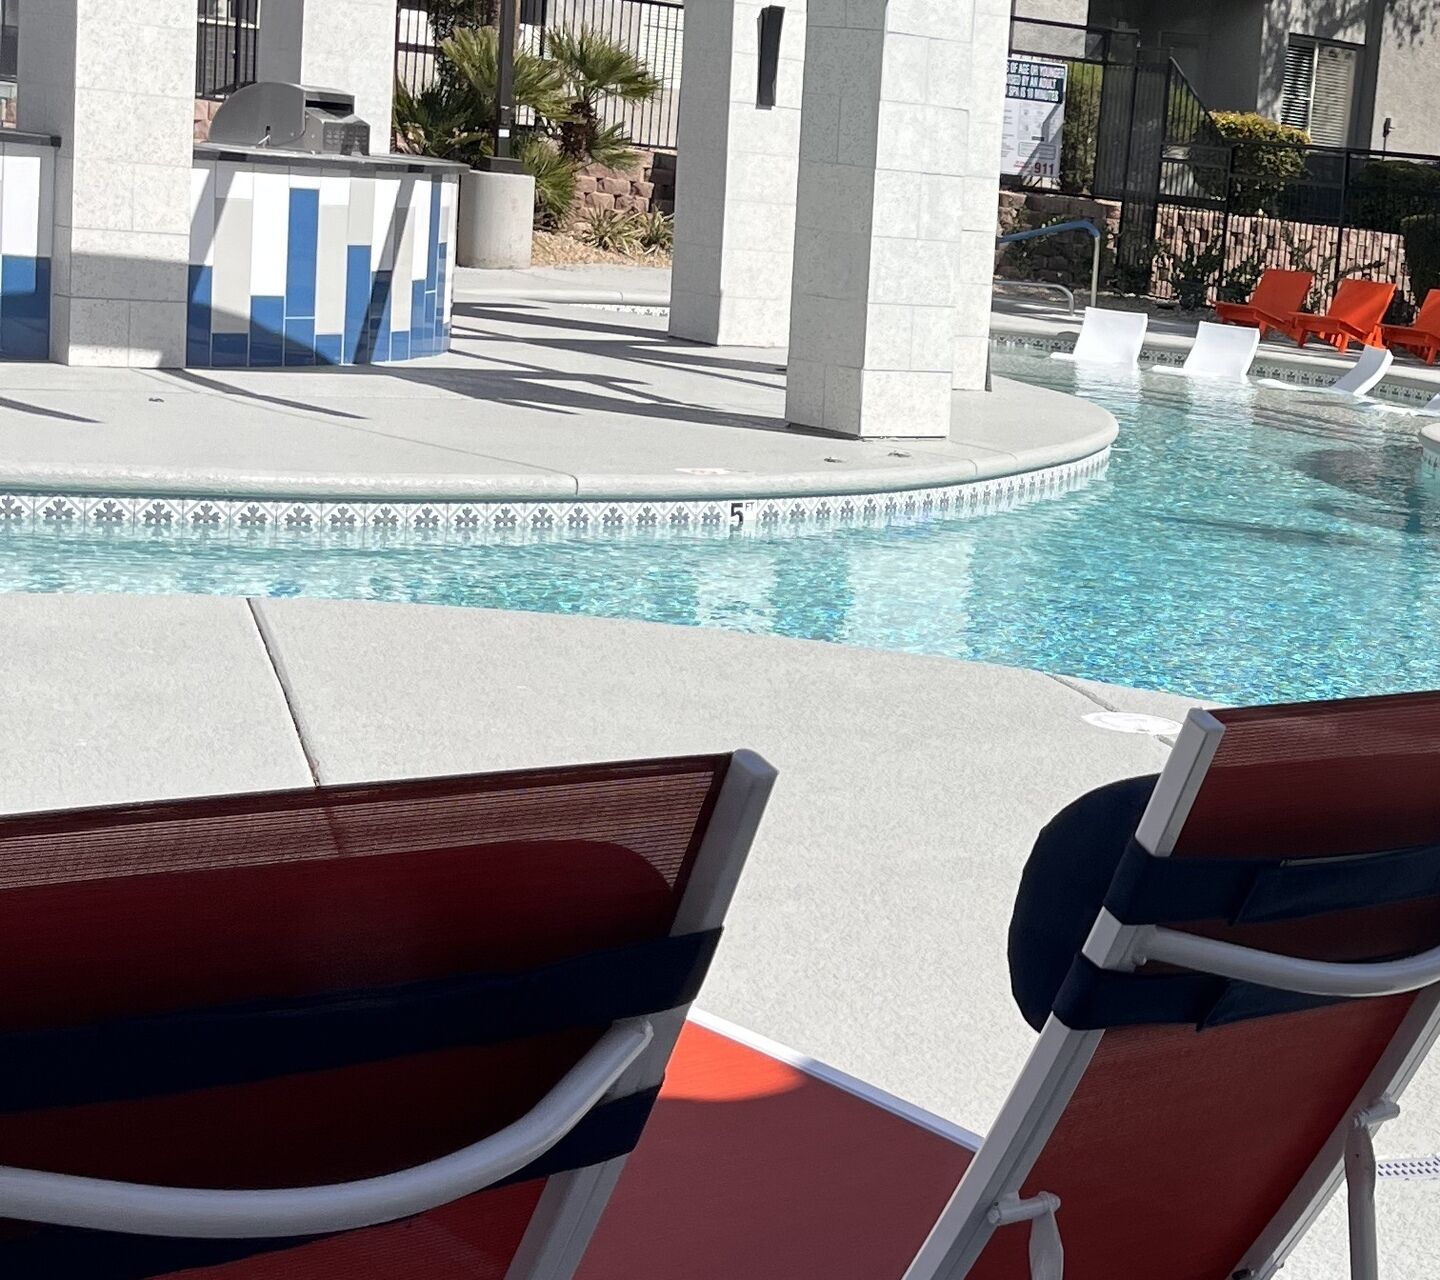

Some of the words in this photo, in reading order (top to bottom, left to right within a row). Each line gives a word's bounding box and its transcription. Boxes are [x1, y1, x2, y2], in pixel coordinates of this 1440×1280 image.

[1030, 76, 1039, 87] AN
[1034, 162, 1055, 175] 911
[730, 502, 744, 532] 5
